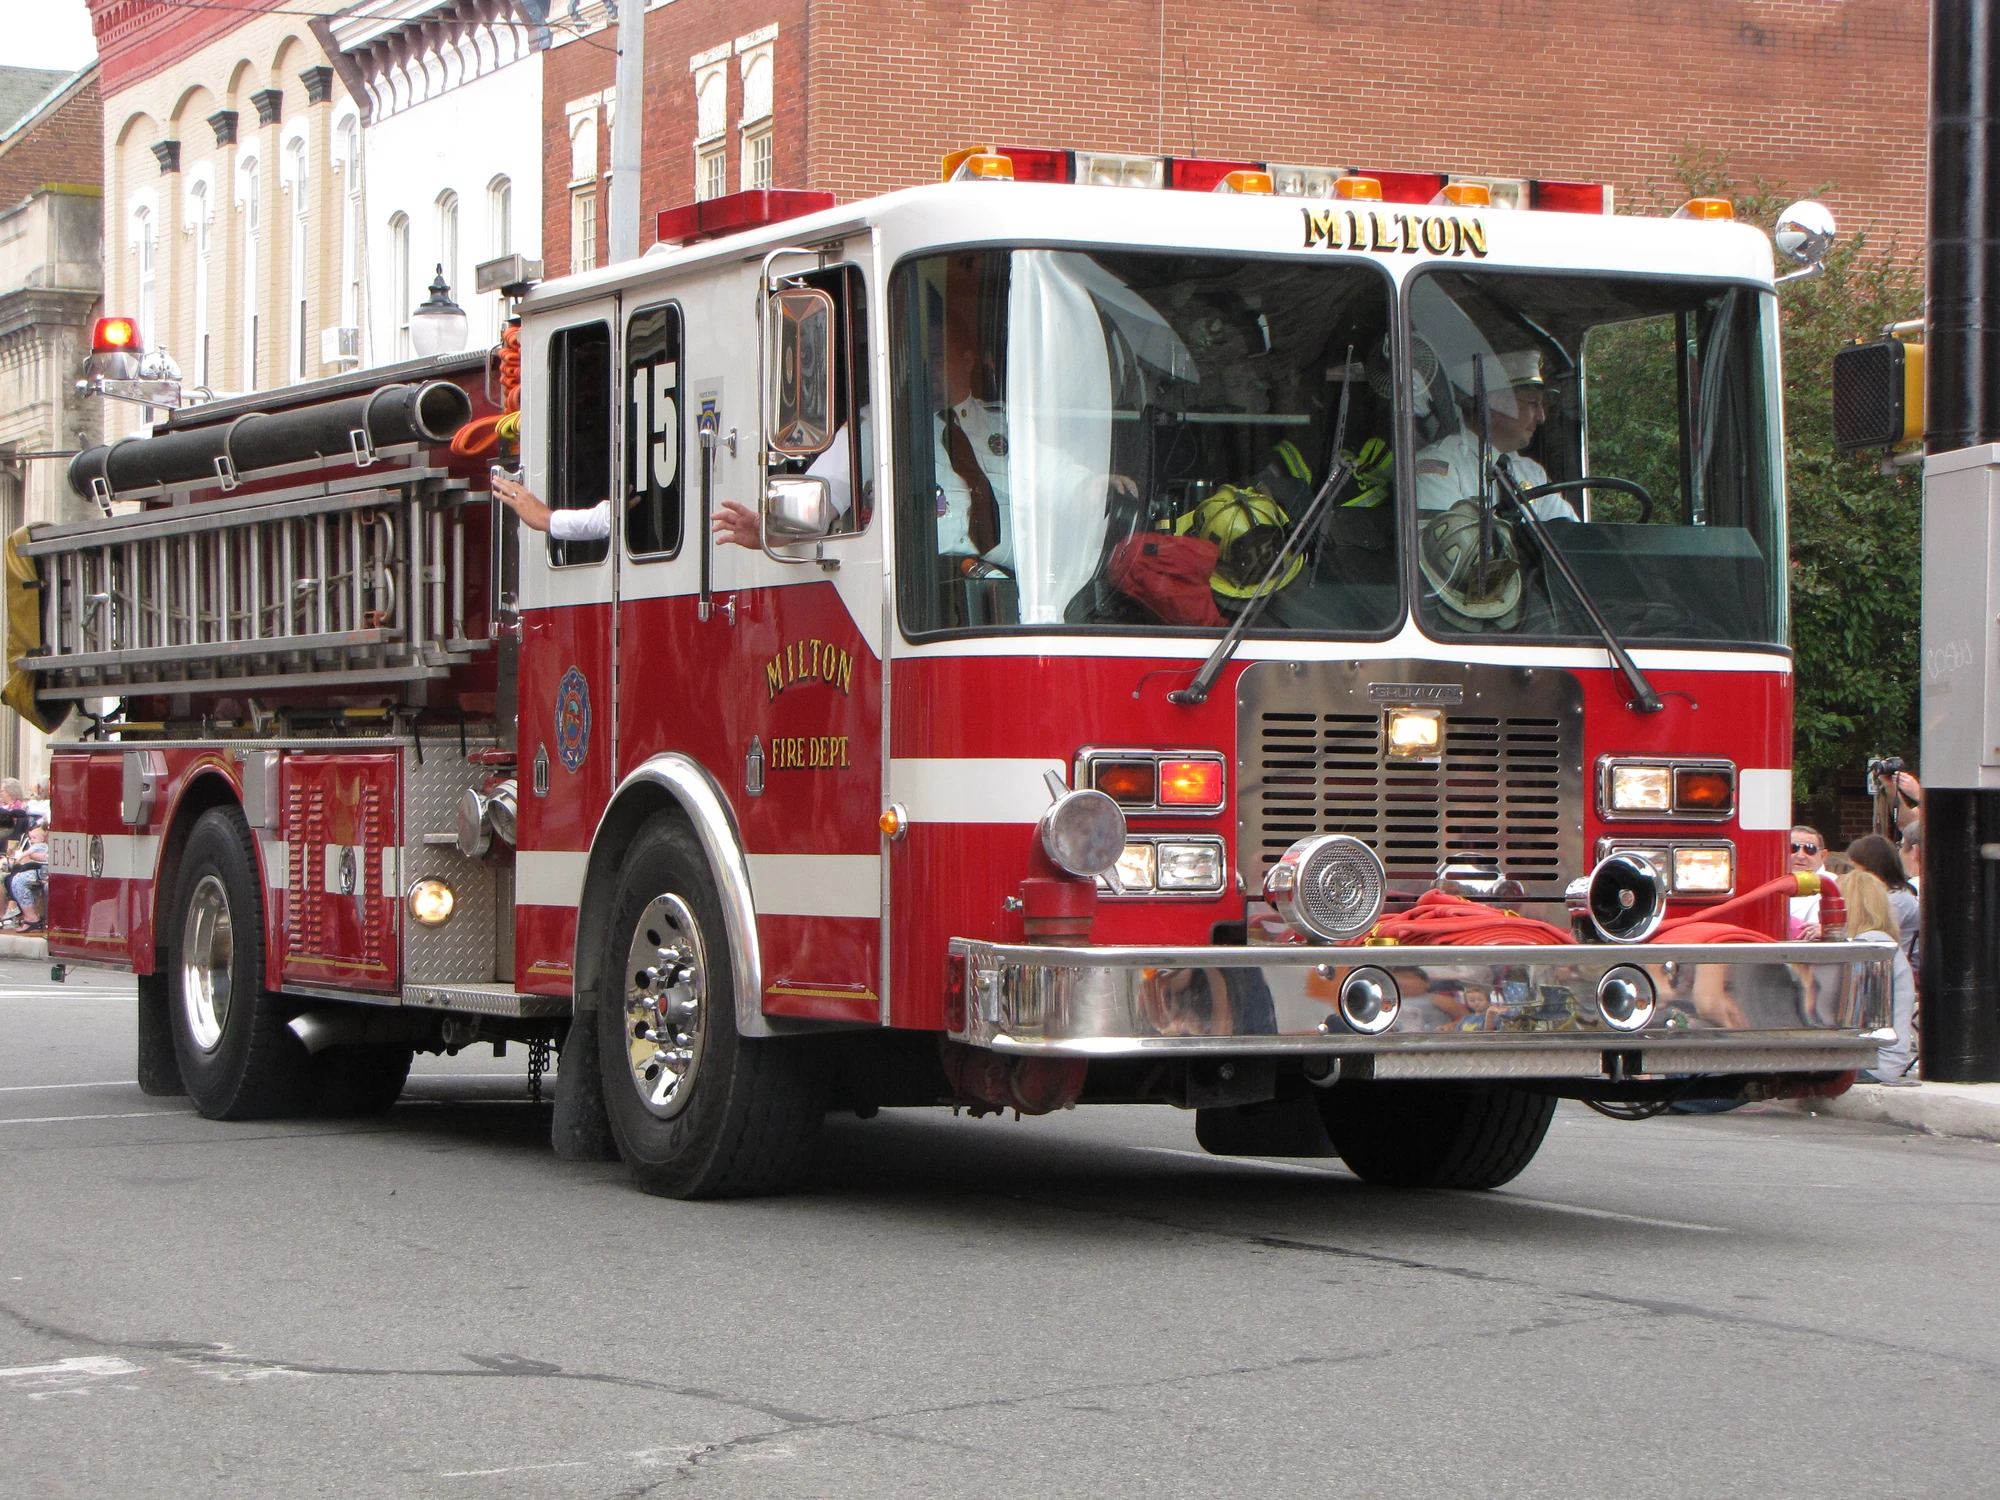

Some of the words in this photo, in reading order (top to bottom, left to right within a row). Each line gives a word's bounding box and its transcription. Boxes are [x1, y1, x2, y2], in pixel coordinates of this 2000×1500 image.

[1300, 207, 1489, 259] MILTON
[633, 361, 677, 493] 15
[766, 638, 854, 700] MILTON
[771, 736, 806, 769] FIRE
[809, 735, 851, 769] DEPT.
